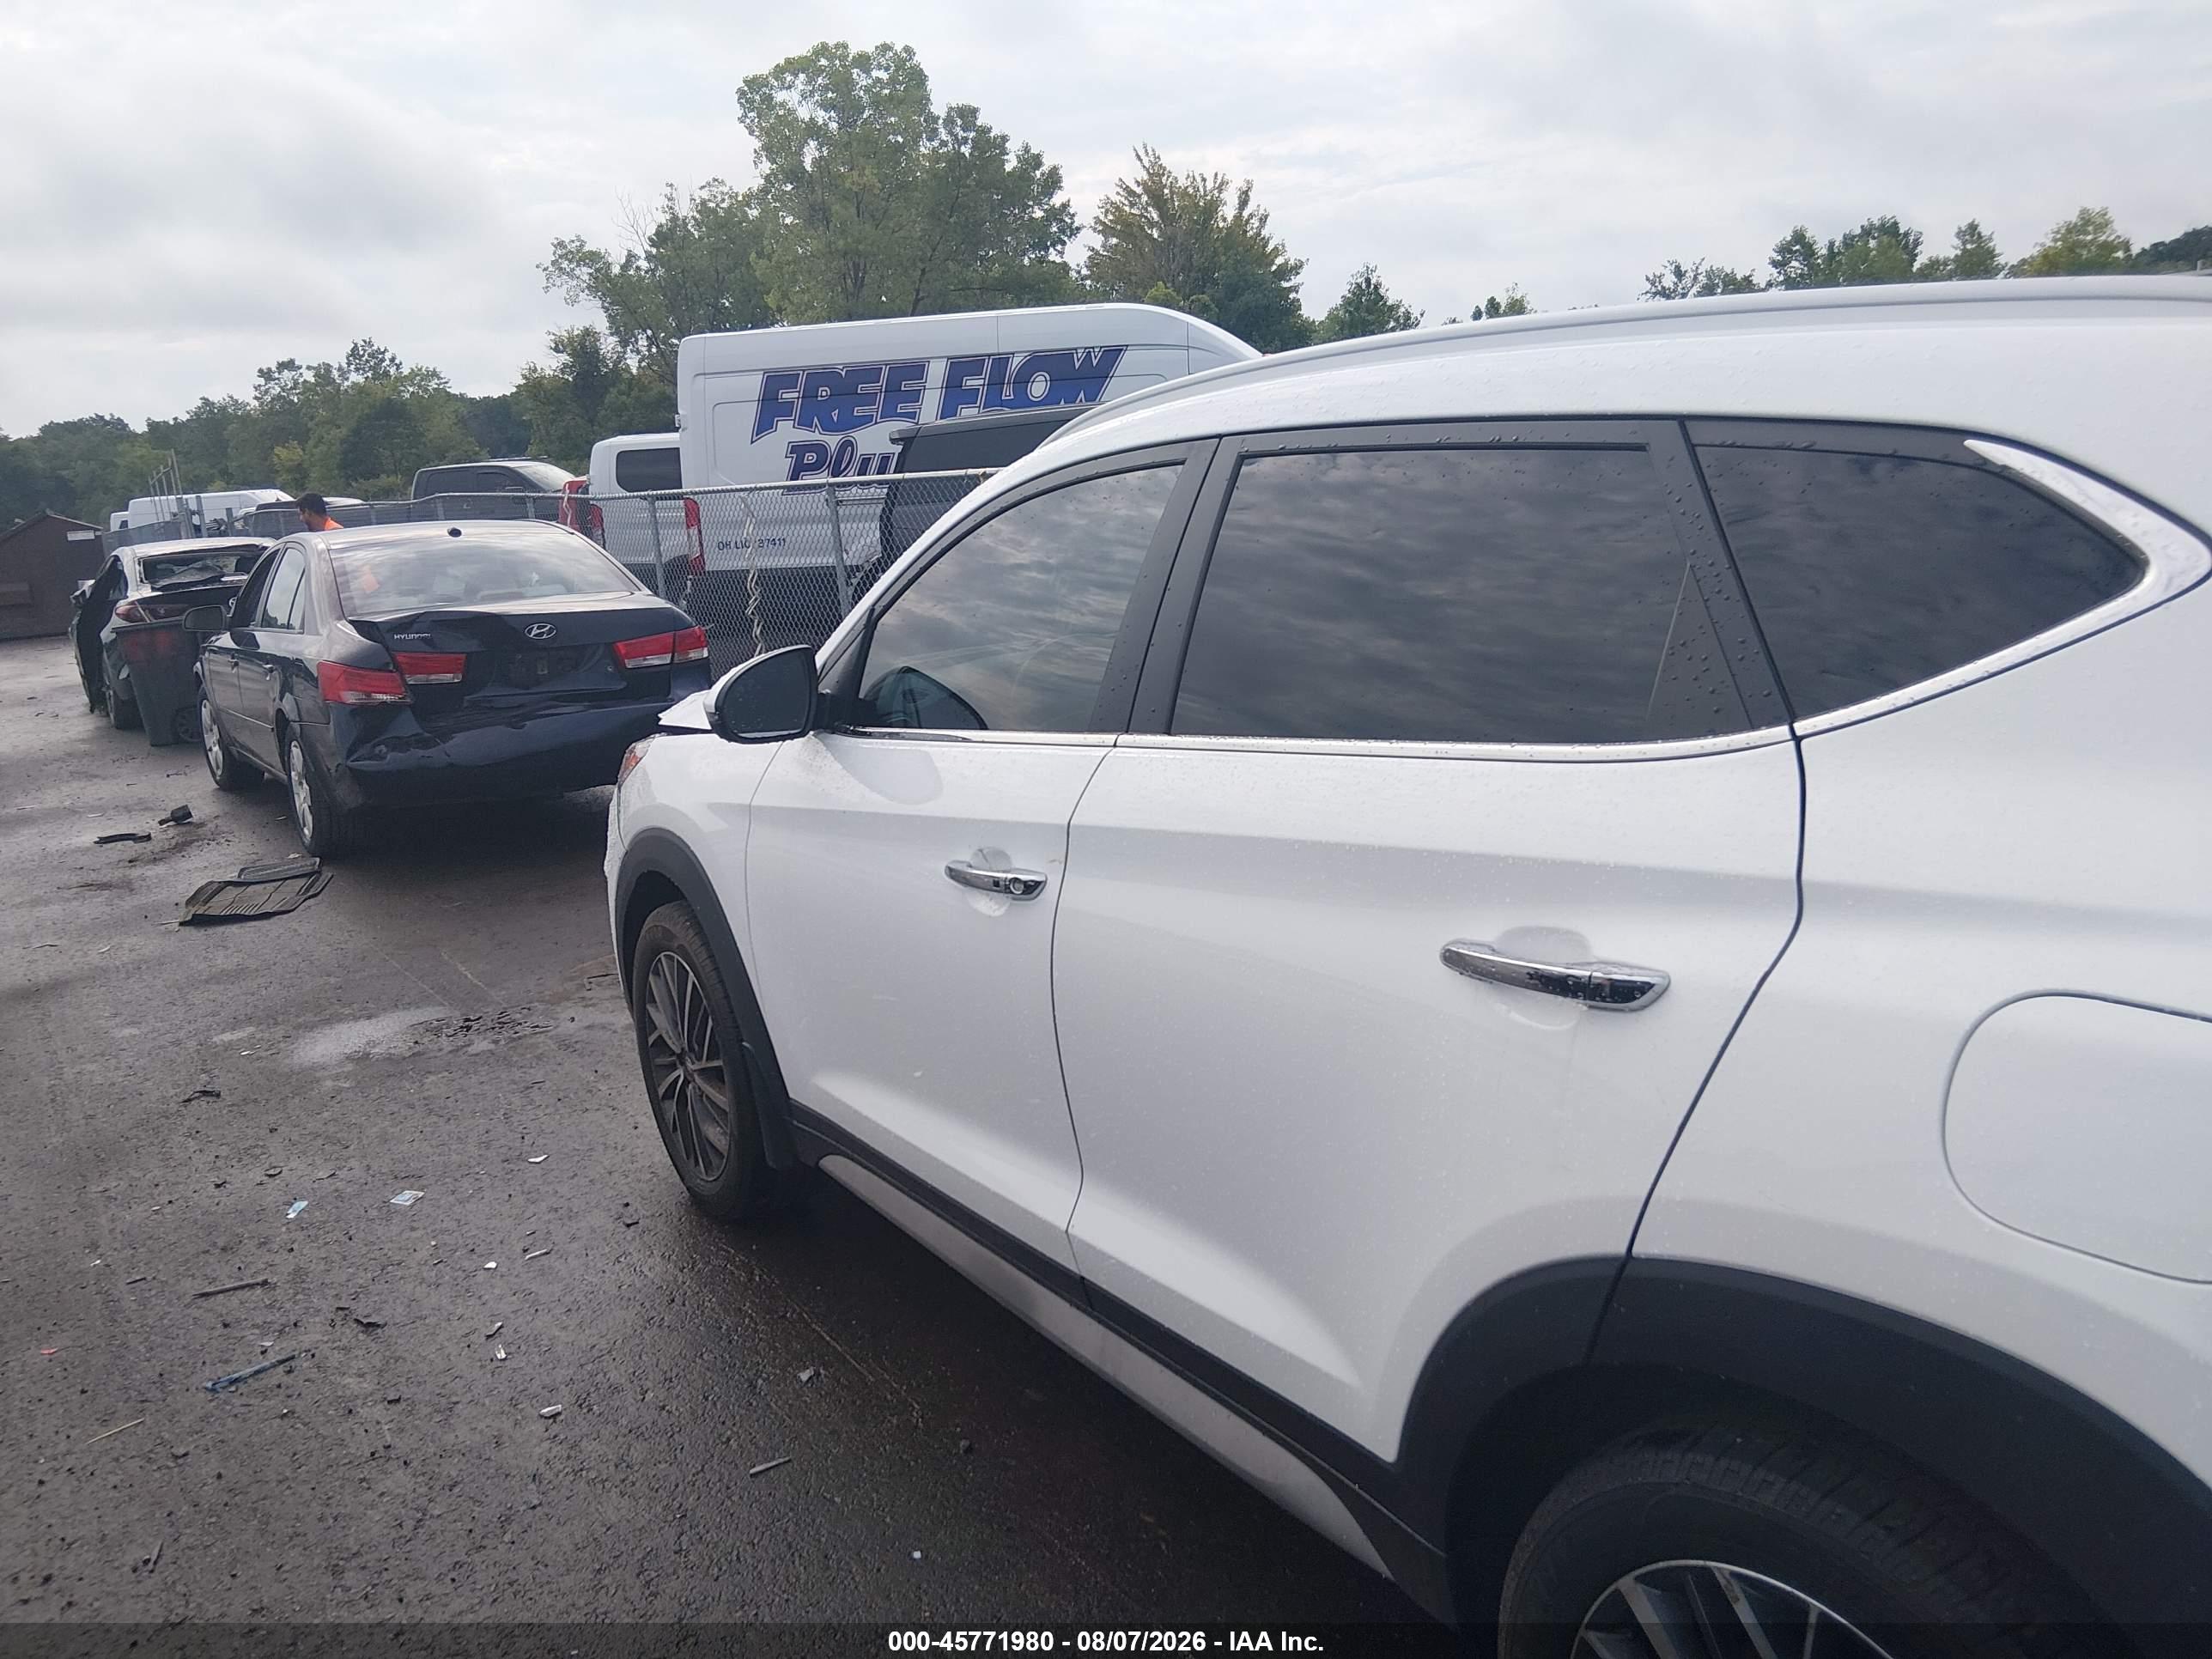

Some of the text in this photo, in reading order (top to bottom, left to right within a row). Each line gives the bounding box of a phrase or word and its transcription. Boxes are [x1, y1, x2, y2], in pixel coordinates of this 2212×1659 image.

[751, 345, 1127, 444] FREE FLOW
[717, 540, 732, 550] OH
